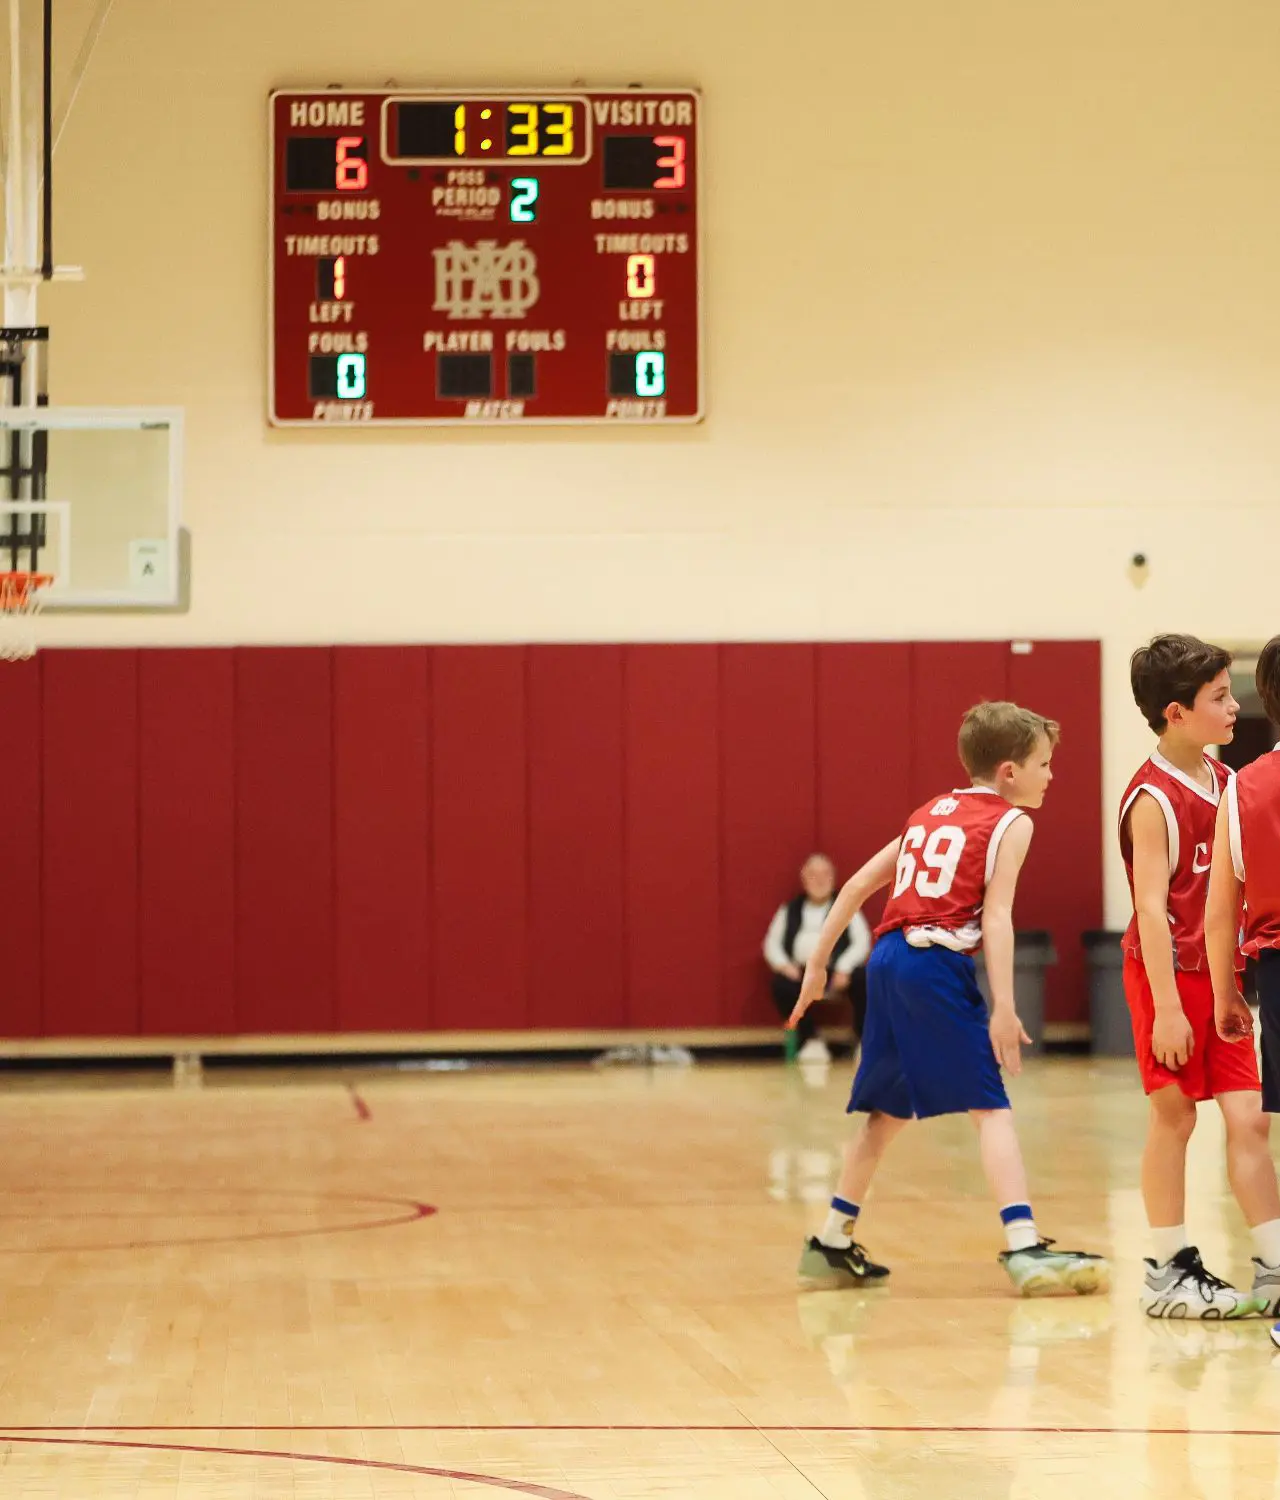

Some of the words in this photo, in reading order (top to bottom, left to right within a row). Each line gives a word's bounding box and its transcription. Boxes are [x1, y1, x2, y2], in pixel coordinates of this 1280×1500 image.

[291, 101, 365, 127] HOME
[592, 100, 692, 126] VISITOR
[454, 103, 574, 156] 1:33
[335, 136, 368, 190] 6
[652, 135, 686, 189] 3
[317, 200, 381, 220] BONUS
[432, 187, 501, 207] PERIOD
[510, 177, 539, 222] 2
[591, 199, 655, 219] BONUS
[285, 235, 379, 256] TIMEOUTS
[594, 233, 689, 254] TIMEOUTS
[333, 255, 345, 299] 1
[625, 253, 656, 298] 0
[309, 301, 354, 323] LEFT
[618, 300, 664, 321] LEFT
[308, 331, 368, 353] FOULS
[424, 331, 493, 352] PLAYER
[506, 329, 566, 351] FOULS
[606, 329, 666, 351] FOULS
[336, 353, 366, 399] 0
[635, 351, 666, 397] 0
[892, 825, 967, 899] 69
